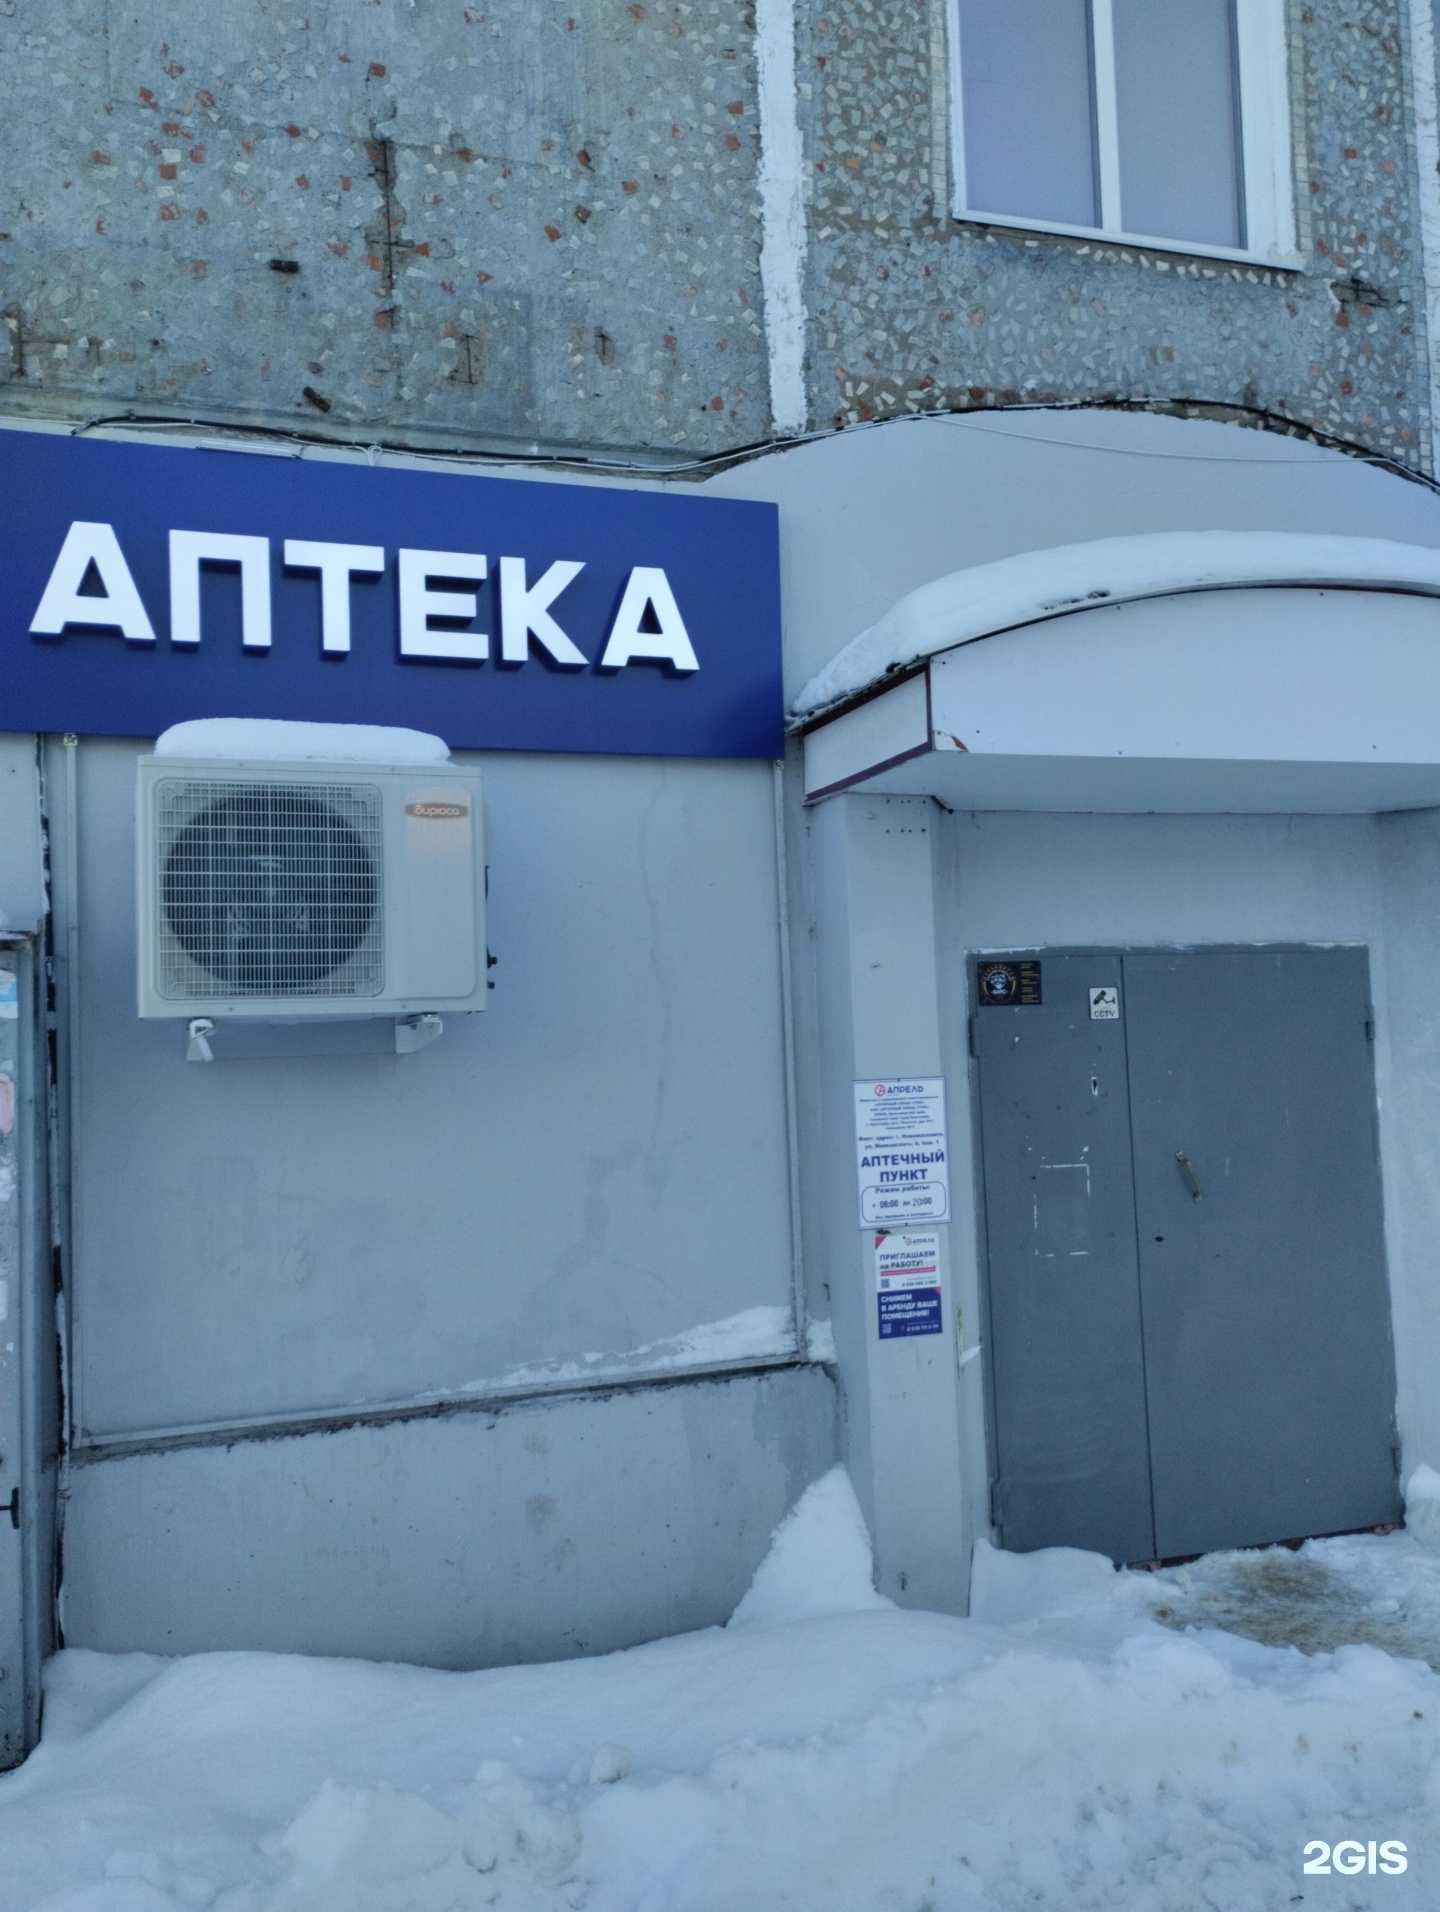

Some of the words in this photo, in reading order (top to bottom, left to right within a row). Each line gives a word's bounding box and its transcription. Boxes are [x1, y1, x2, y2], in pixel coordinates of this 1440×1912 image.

[29, 521, 700, 674] АПТЕКА
[1094, 1009, 1116, 1018] CCTV
[861, 1149, 945, 1168] АПТЕЧНЫЙ
[879, 1168, 928, 1183] ПУНКТ
[880, 1250, 936, 1261] ПРИГЛАШАЕМ
